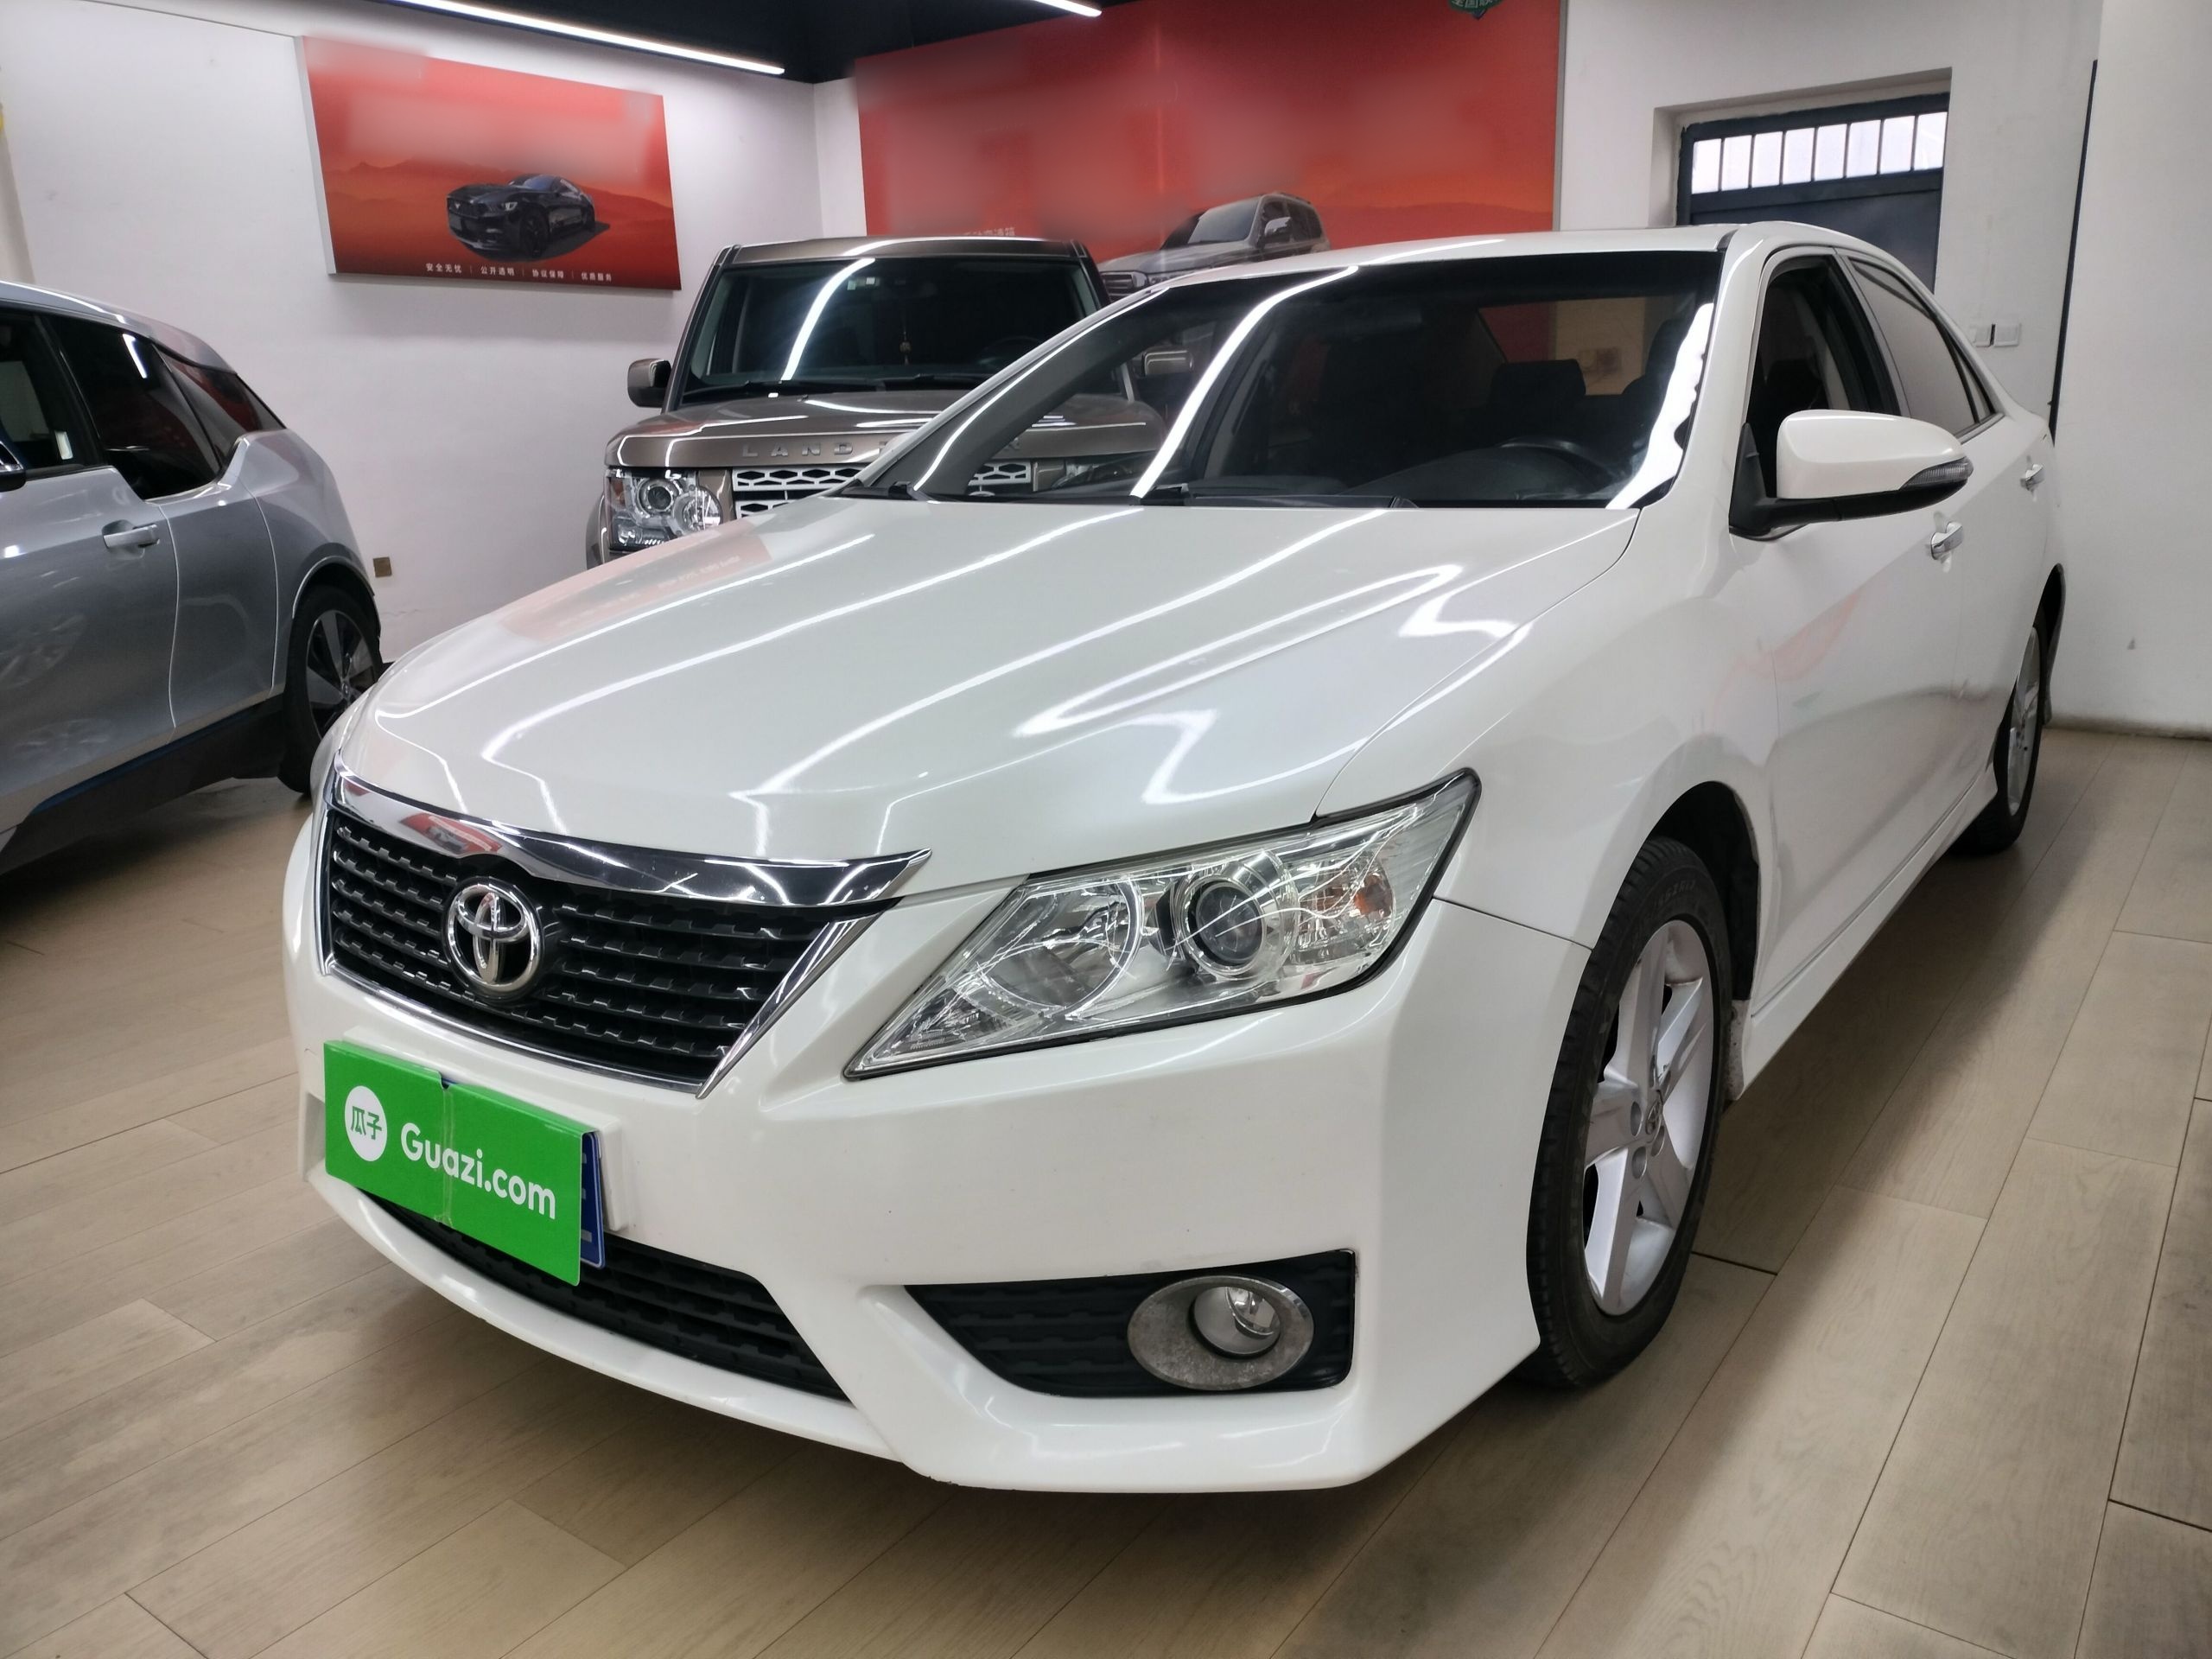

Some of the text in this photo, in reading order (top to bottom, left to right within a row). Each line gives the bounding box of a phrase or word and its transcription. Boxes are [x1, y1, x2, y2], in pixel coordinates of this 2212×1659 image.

[425, 263, 462, 274] 安全无忧
[480, 265, 515, 276] 公开透明
[741, 440, 854, 457] LAND
[350, 1105, 383, 1141] 瓜子
[400, 1122, 556, 1220] Guazi.com
